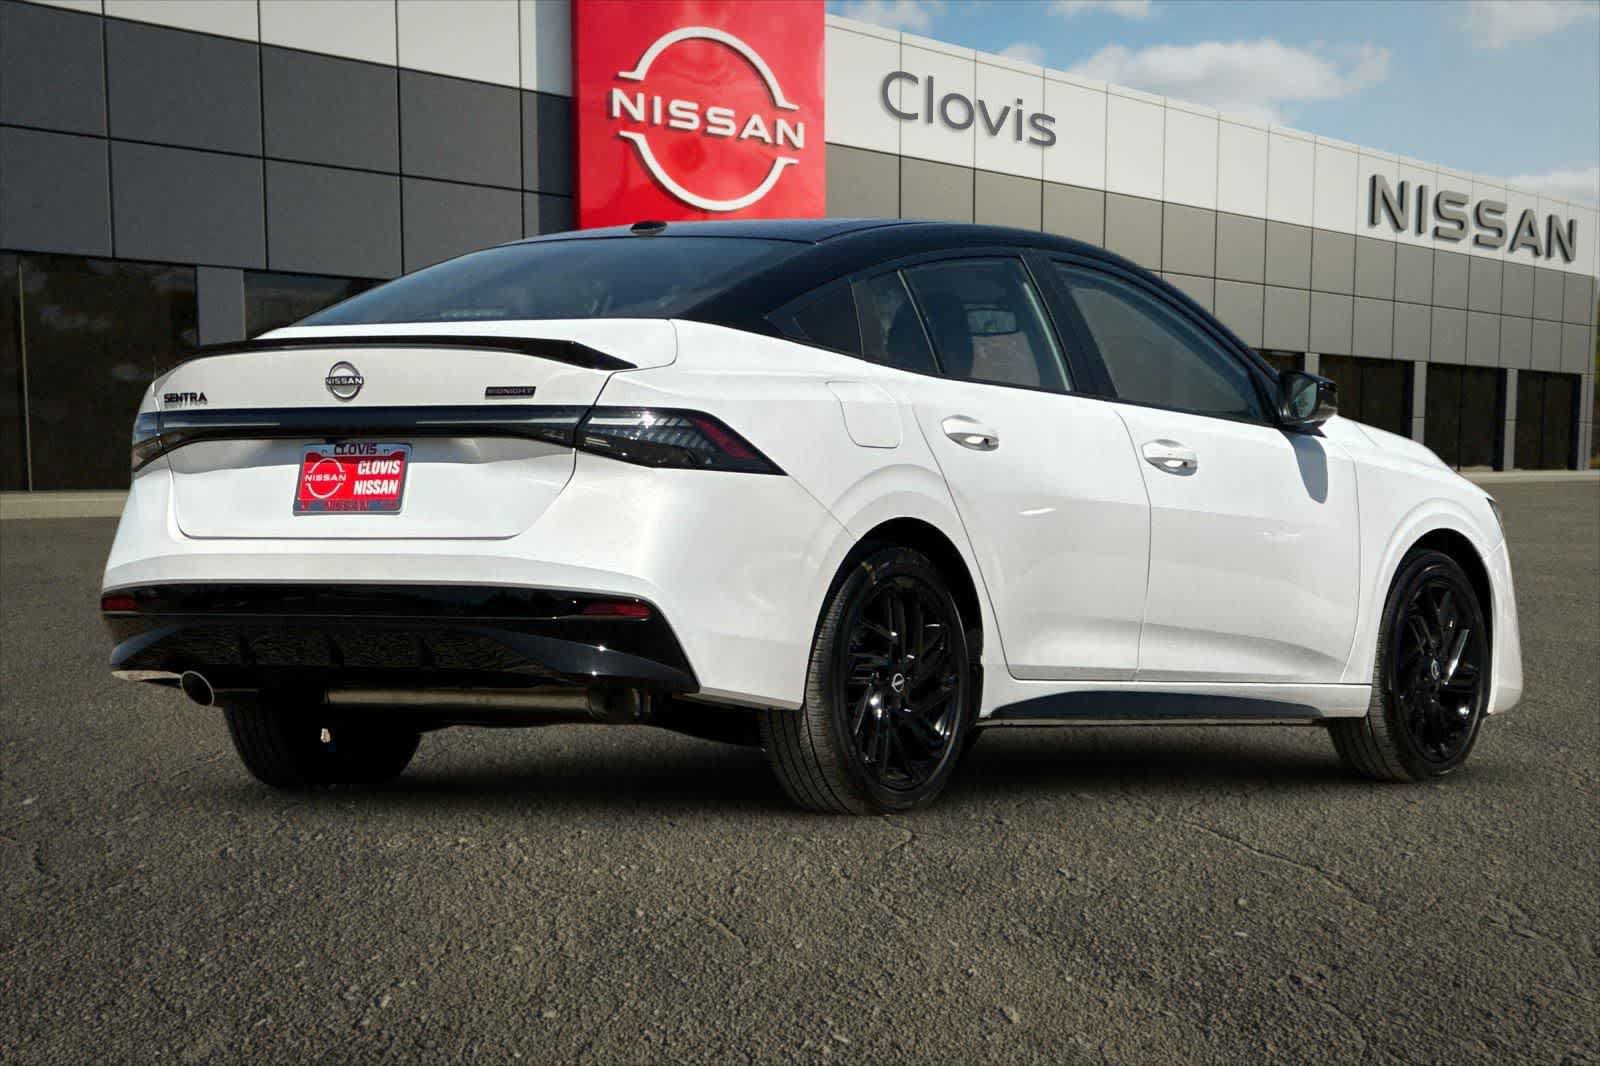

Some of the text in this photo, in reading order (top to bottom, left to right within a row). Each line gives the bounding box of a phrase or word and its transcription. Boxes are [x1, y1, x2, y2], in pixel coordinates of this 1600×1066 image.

[881, 71, 1057, 147] Clovis
[609, 88, 805, 150] NISSAN
[1368, 174, 1577, 263] NISSAN
[325, 376, 364, 385] NISSAN
[164, 392, 208, 403] SENTRA
[334, 443, 377, 455] CLOVIS
[358, 460, 400, 475] CLOVIS
[305, 473, 346, 481] NISSAN
[353, 480, 398, 495] NISSAN
